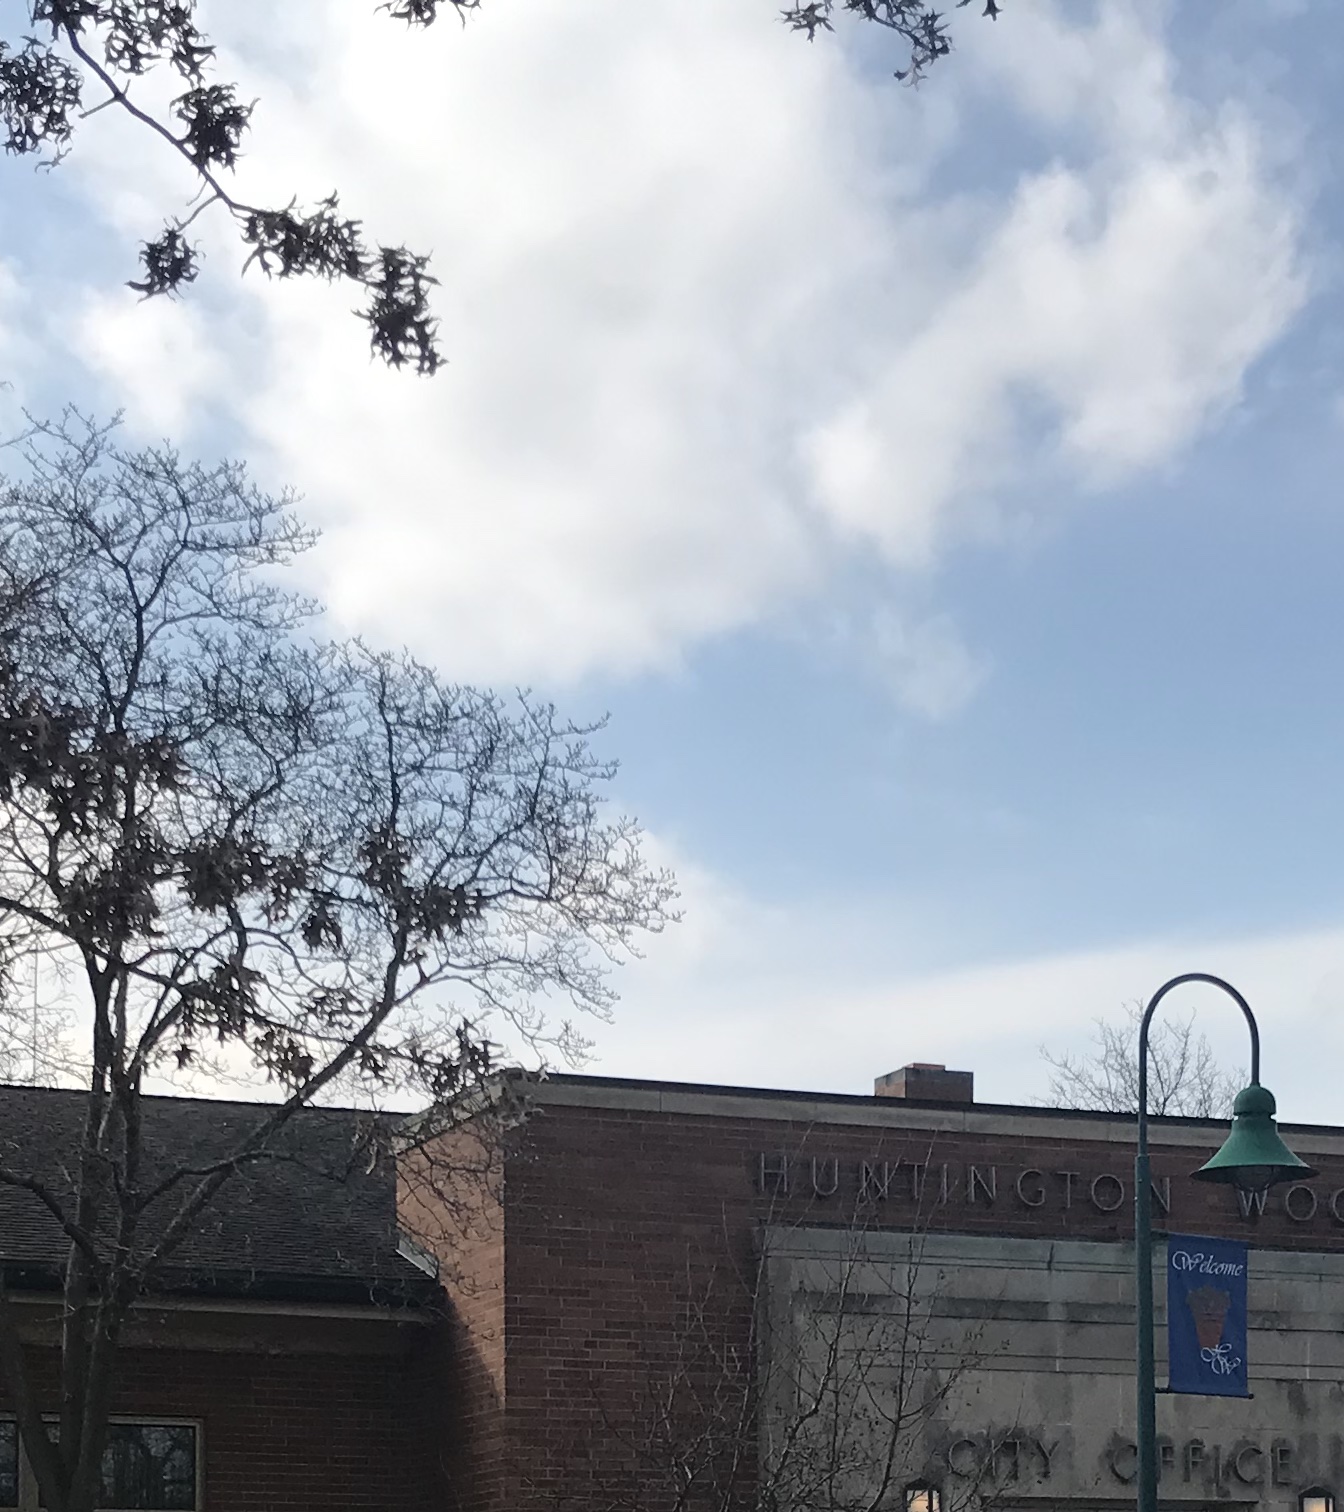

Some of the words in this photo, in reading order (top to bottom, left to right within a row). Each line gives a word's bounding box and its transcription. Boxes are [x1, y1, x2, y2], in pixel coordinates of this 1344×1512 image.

[760, 1151, 1171, 1213] HUNTINGTON
[1172, 1250, 1244, 1277] Welcome
[948, 1437, 1060, 1480] CITY
[1110, 1442, 1296, 1486] OFFICE
